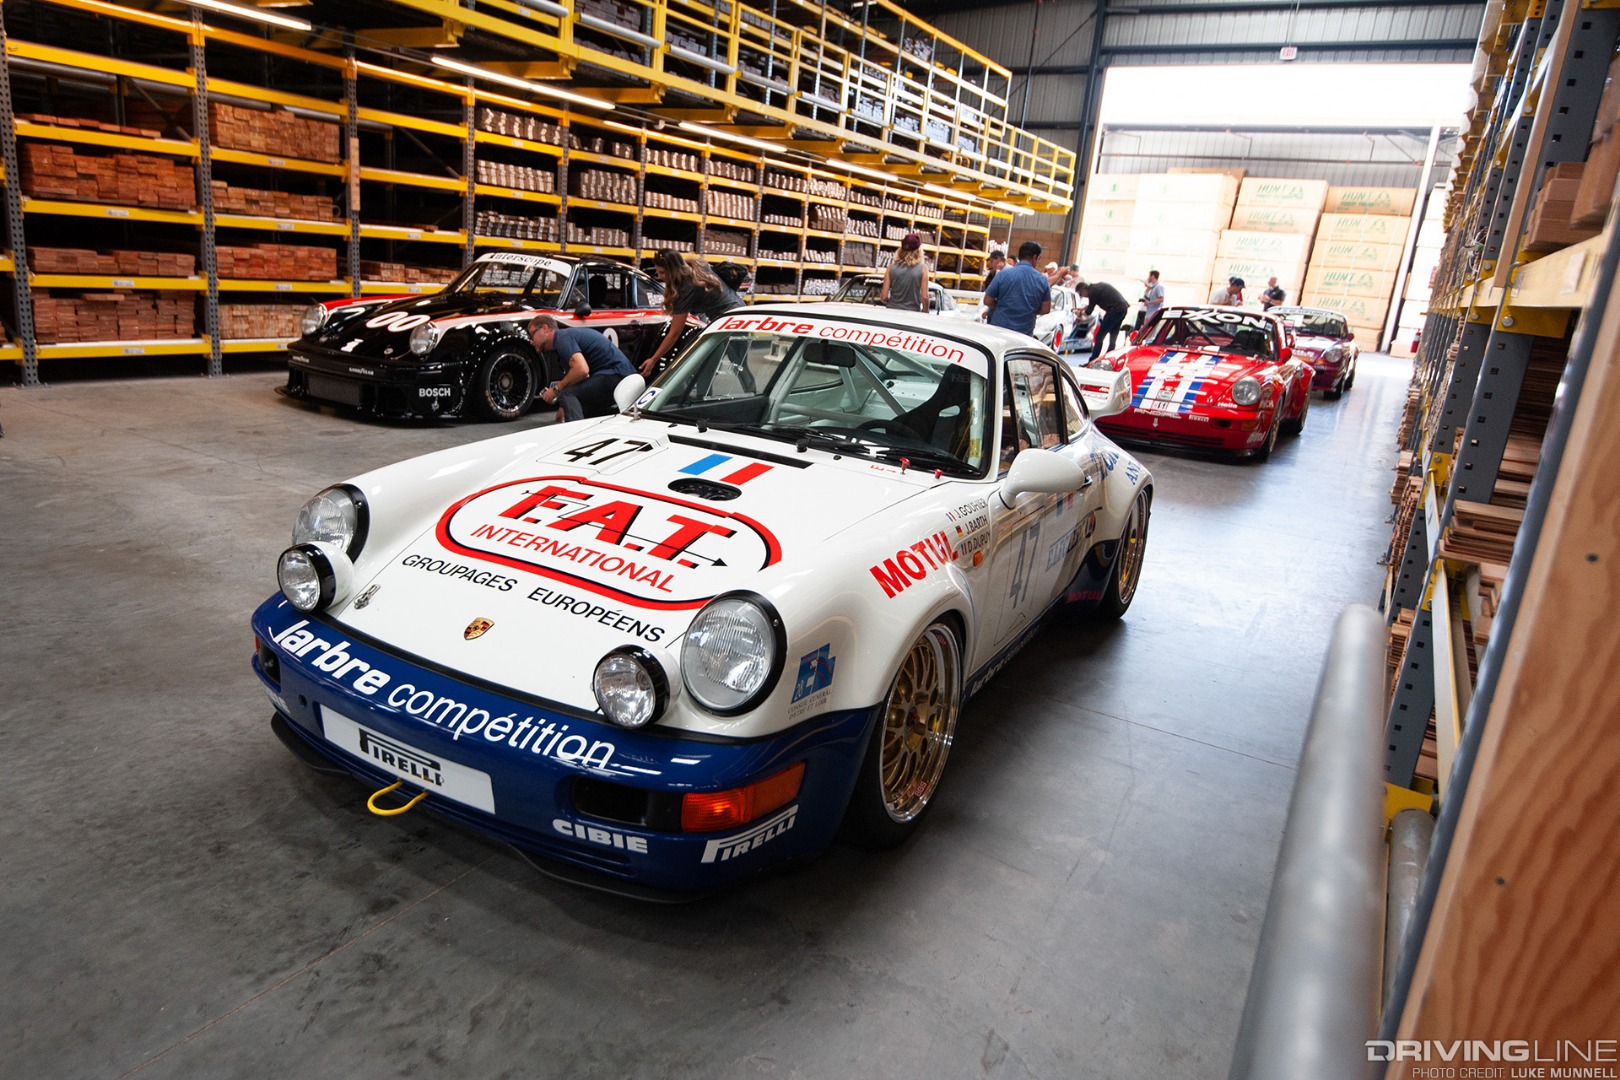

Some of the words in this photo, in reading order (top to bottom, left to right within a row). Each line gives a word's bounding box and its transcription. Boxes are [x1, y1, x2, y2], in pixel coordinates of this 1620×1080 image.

[1342, 191, 1372, 200] HUNT
[1324, 272, 1356, 281] HUNT
[366, 311, 430, 332] 00
[717, 316, 815, 335] larbre
[818, 323, 965, 363] compétition
[1162, 309, 1267, 330] EXXON
[418, 387, 451, 398] BOSCH
[1217, 401, 1238, 409] Hella
[563, 437, 654, 466] 47
[470, 523, 675, 593] INTERNATIONAL
[869, 530, 959, 599] MOTUL
[1009, 522, 1041, 609] 47
[401, 554, 518, 592] GROUPAGES
[527, 586, 666, 643] EUROPÉENS
[274, 620, 391, 695] larbre
[387, 684, 615, 769] compétition
[358, 727, 445, 787] PIRELLI
[700, 804, 799, 864] PIRELLI
